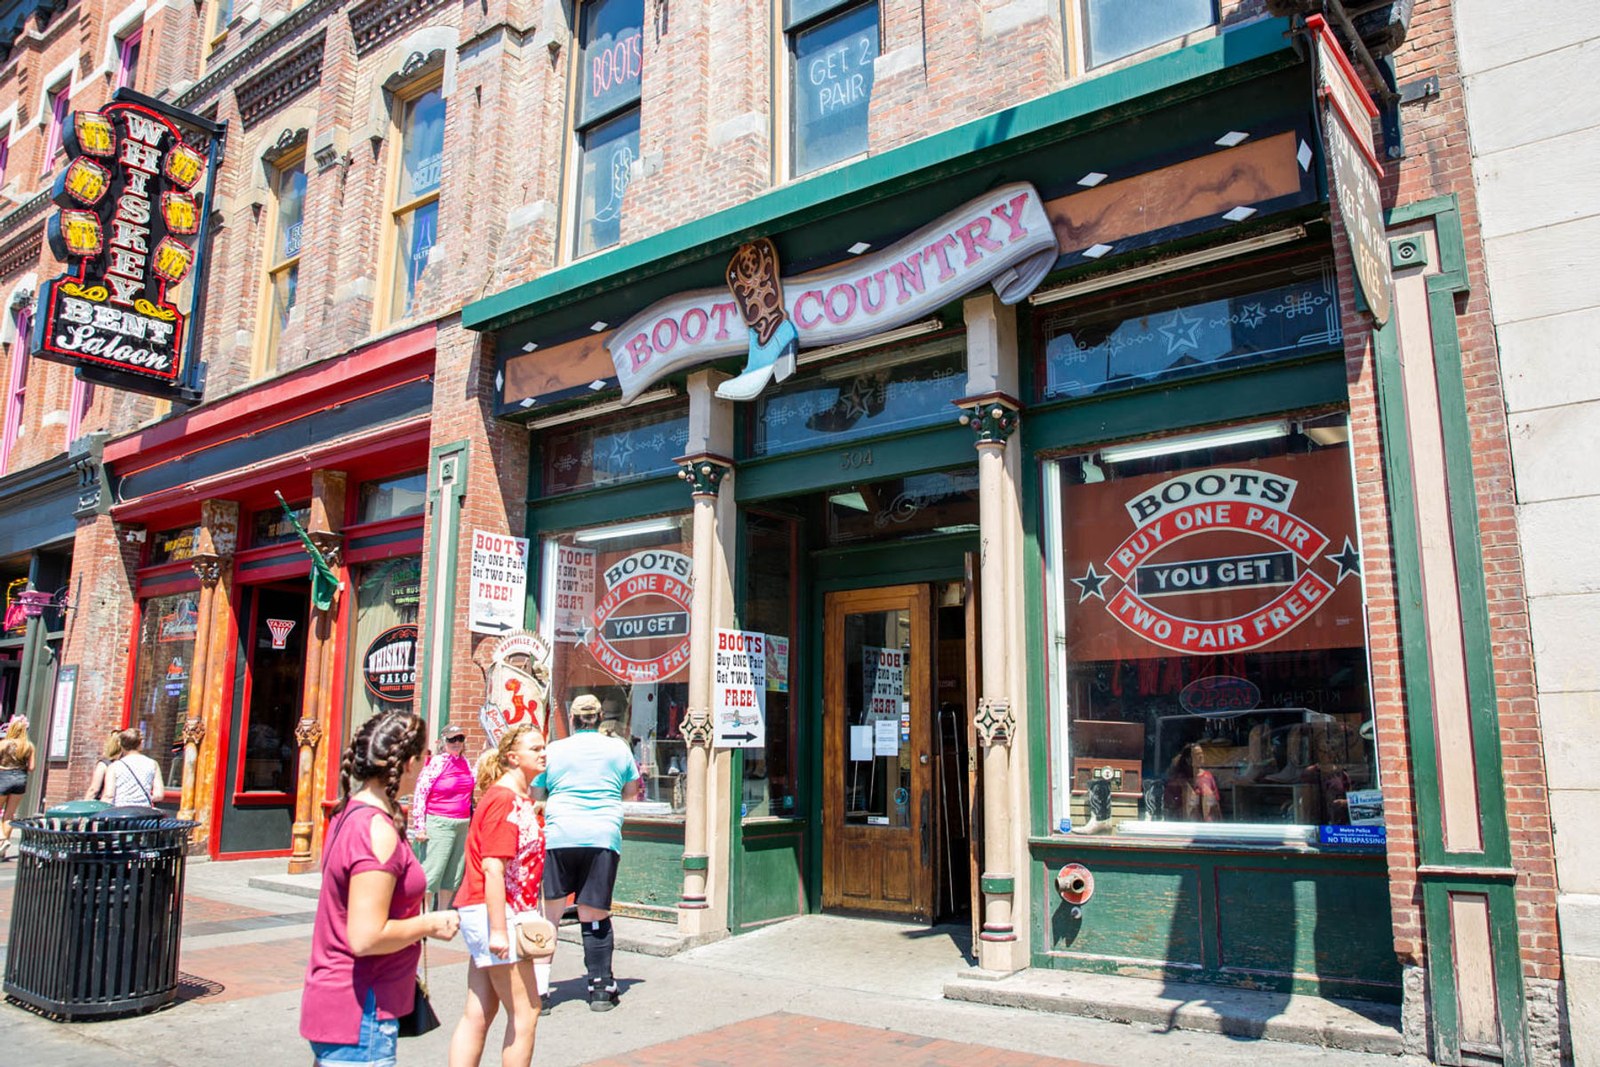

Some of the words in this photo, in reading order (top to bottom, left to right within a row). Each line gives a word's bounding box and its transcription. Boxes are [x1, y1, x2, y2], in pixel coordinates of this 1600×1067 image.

[593, 34, 643, 97] BOOTS
[811, 47, 849, 85] GET
[859, 38, 873, 66] 2
[819, 73, 864, 115] PAIR
[104, 111, 168, 307] WHISKEY
[624, 301, 736, 375] BOOT
[794, 192, 1030, 331] COUNTRY
[61, 297, 173, 345] BENT
[56, 325, 169, 371] Saloon
[841, 448, 873, 469] 304
[1131, 474, 1290, 522] BOOTS
[476, 533, 525, 557] BOOTS
[1117, 522, 1163, 569] BUY
[1175, 504, 1231, 530] ONE
[1245, 506, 1310, 549] PAIR
[473, 566, 483, 578] Get
[485, 568, 503, 581] TWO
[506, 572, 524, 584] Pair
[474, 550, 486, 566] Buy
[489, 554, 504, 567] ONE
[507, 557, 525, 570] Pair
[606, 553, 689, 587] BOOTS
[1154, 566, 1208, 589] YOU
[1217, 559, 1271, 582] GET
[479, 583, 513, 602] FREE!
[595, 589, 621, 620] BUY
[627, 576, 657, 593] ONE
[614, 619, 643, 636] YOU
[647, 616, 676, 633] GET
[1119, 597, 1171, 639] TWO
[1182, 624, 1246, 648] PAIR
[1252, 579, 1321, 636] FREE
[369, 640, 412, 672] WHISKEY
[718, 632, 762, 653] BOOTS
[594, 641, 622, 674] TWO
[626, 663, 659, 679] PAIR
[664, 641, 691, 671] FRE
[717, 653, 731, 670] Buy
[733, 654, 747, 668] ONE
[749, 655, 763, 669] Pair
[379, 672, 416, 685] SALOO
[717, 670, 728, 684] Get
[731, 671, 747, 685] TWO
[750, 672, 764, 686] Pair
[725, 688, 756, 708] FREE!
[1187, 685, 1251, 709] OPEN
